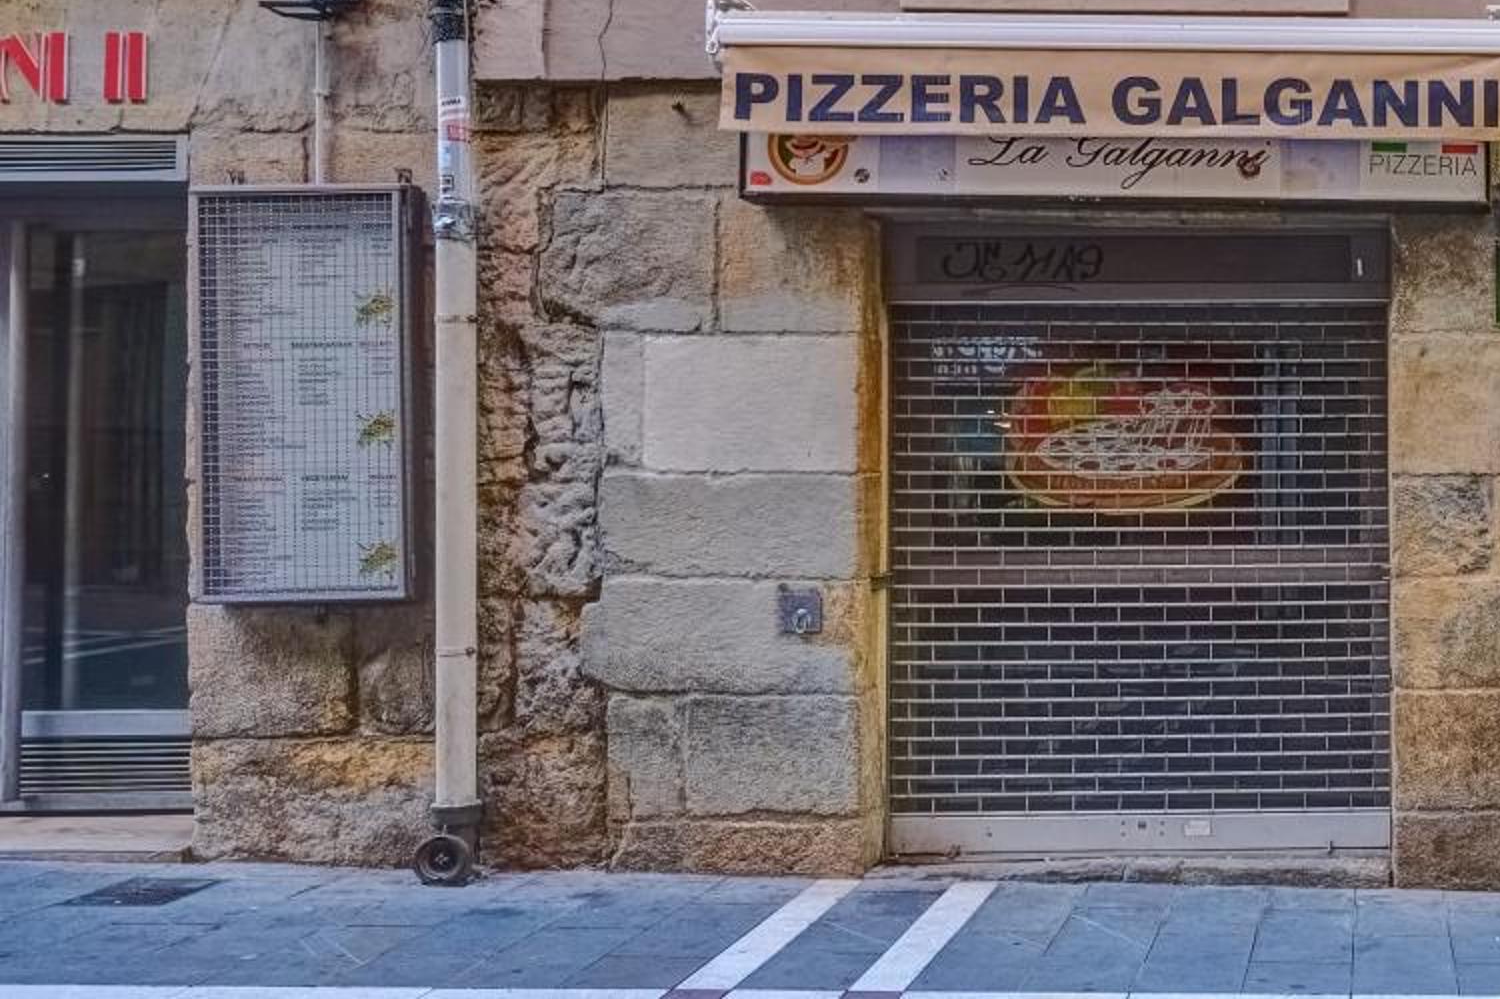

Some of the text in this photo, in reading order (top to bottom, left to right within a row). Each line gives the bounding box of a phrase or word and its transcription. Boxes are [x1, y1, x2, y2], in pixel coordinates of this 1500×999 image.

[732, 73, 1500, 128] PIZZERIA GALGANNI
[1368, 154, 1478, 177] PIZZERIA
